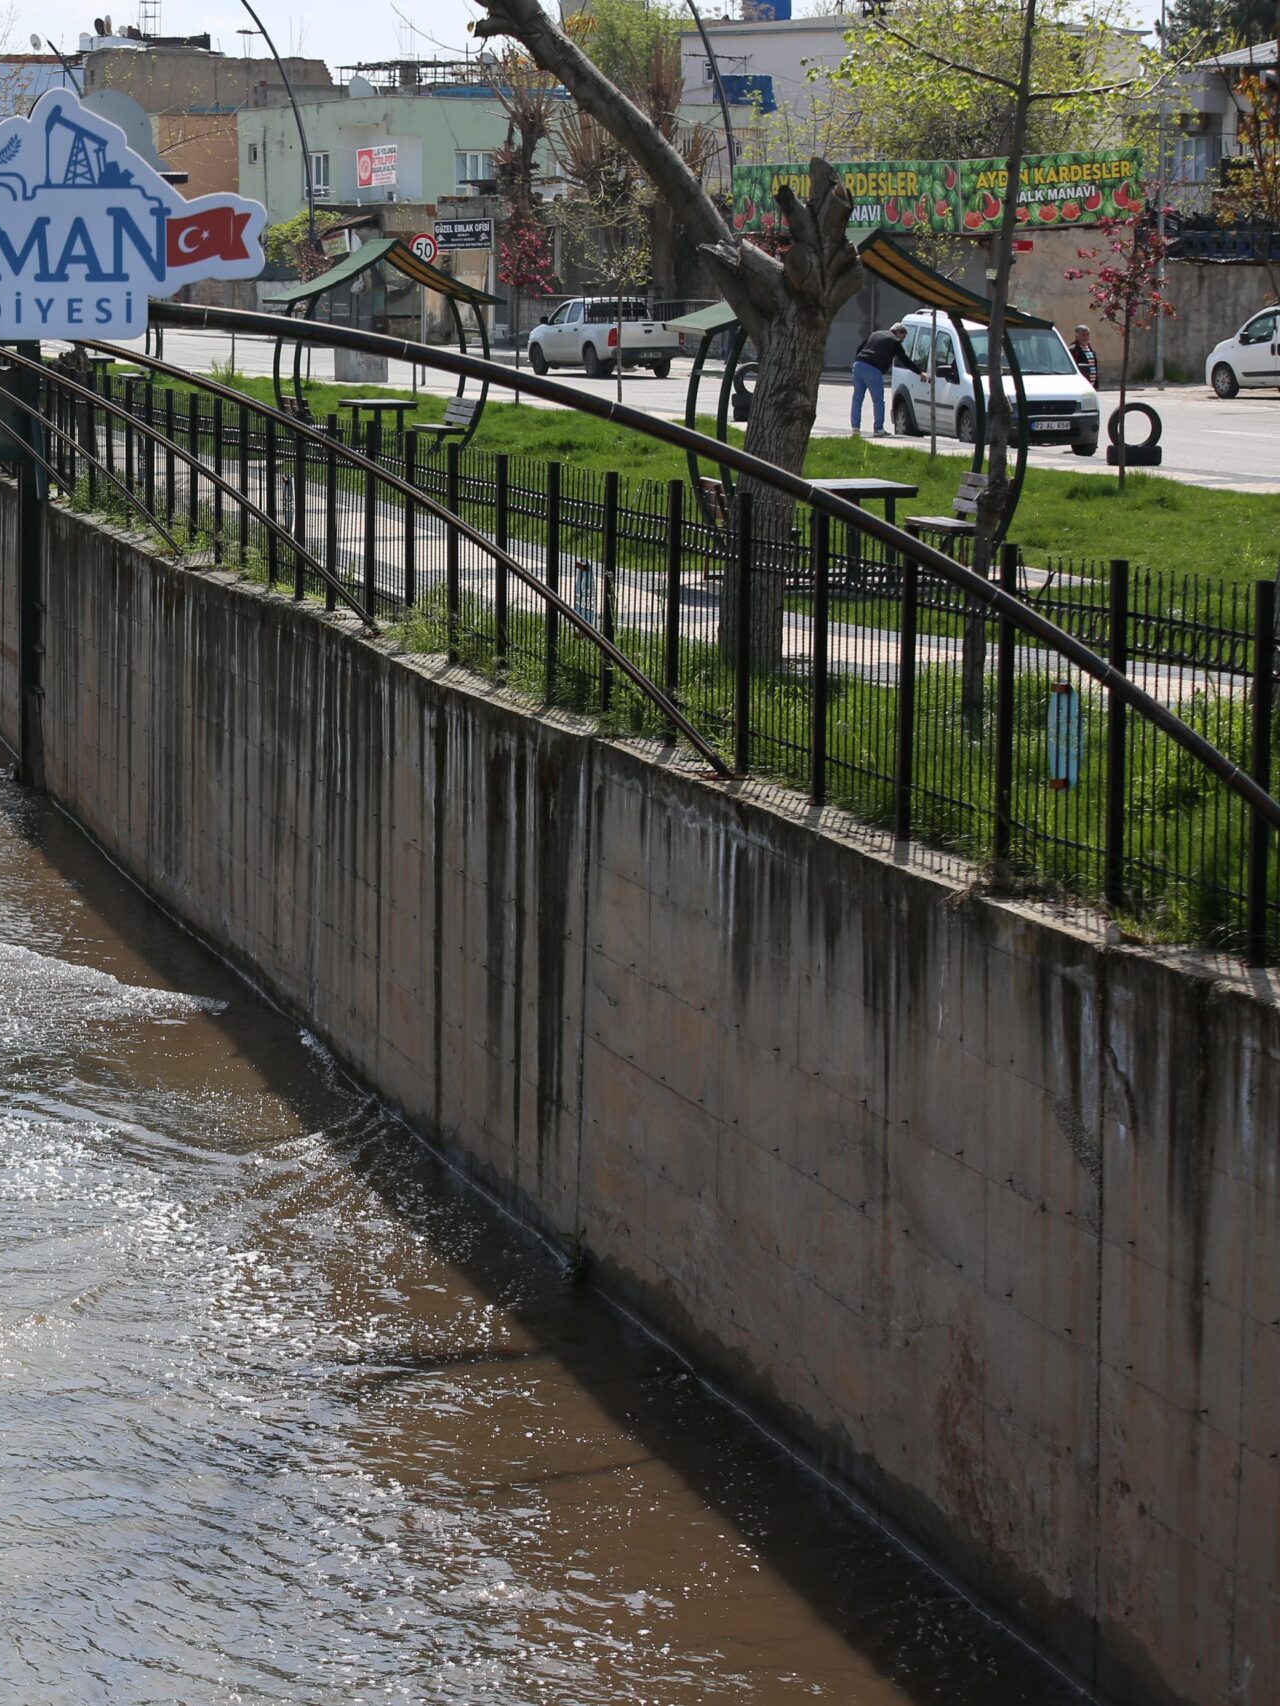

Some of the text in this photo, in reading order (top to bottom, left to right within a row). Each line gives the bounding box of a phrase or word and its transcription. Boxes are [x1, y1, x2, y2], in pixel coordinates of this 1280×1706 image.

[846, 172, 918, 197] RDEŞLER
[976, 168, 1029, 189] AYDN
[1016, 185, 1096, 203] ALK MANAVI
[850, 204, 881, 222] NAVI
[435, 223, 453, 233] GÜZEL
[454, 223, 473, 233] EMLAK
[416, 242, 432, 258] 50
